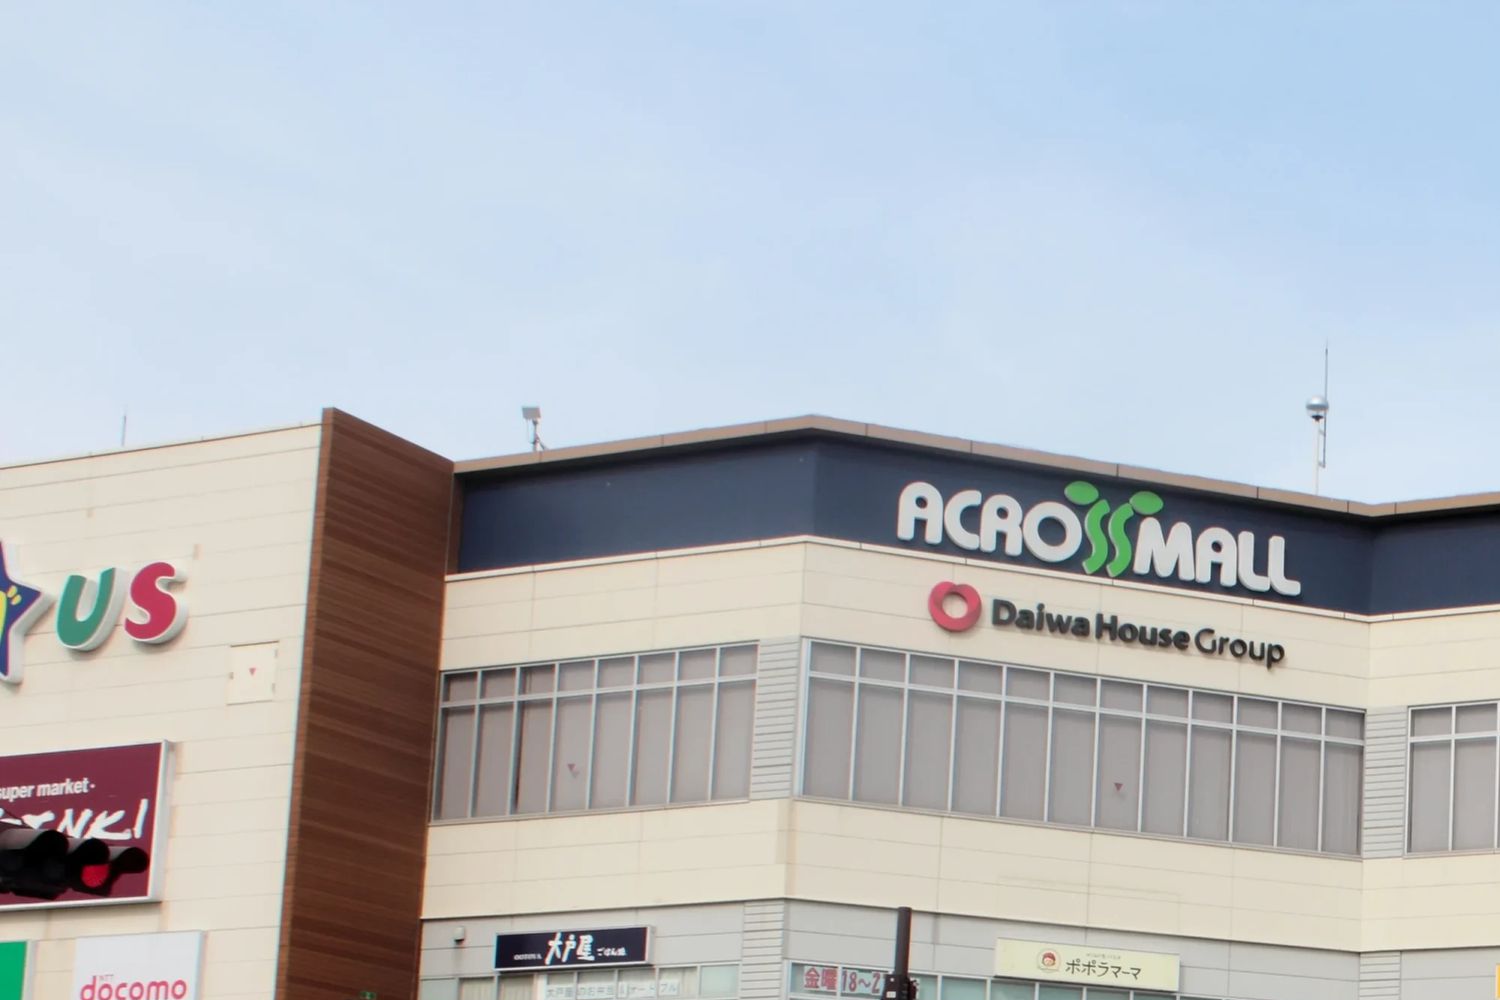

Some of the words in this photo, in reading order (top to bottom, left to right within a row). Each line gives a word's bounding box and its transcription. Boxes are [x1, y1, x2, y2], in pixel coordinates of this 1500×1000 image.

[991, 598, 1090, 637] Daiwa
[1095, 614, 1190, 650] House
[1194, 627, 1285, 671] Group
[36, 777, 89, 797] market
[545, 931, 596, 965] 大戸屋
[1065, 958, 1142, 981] ポポラマーマ
